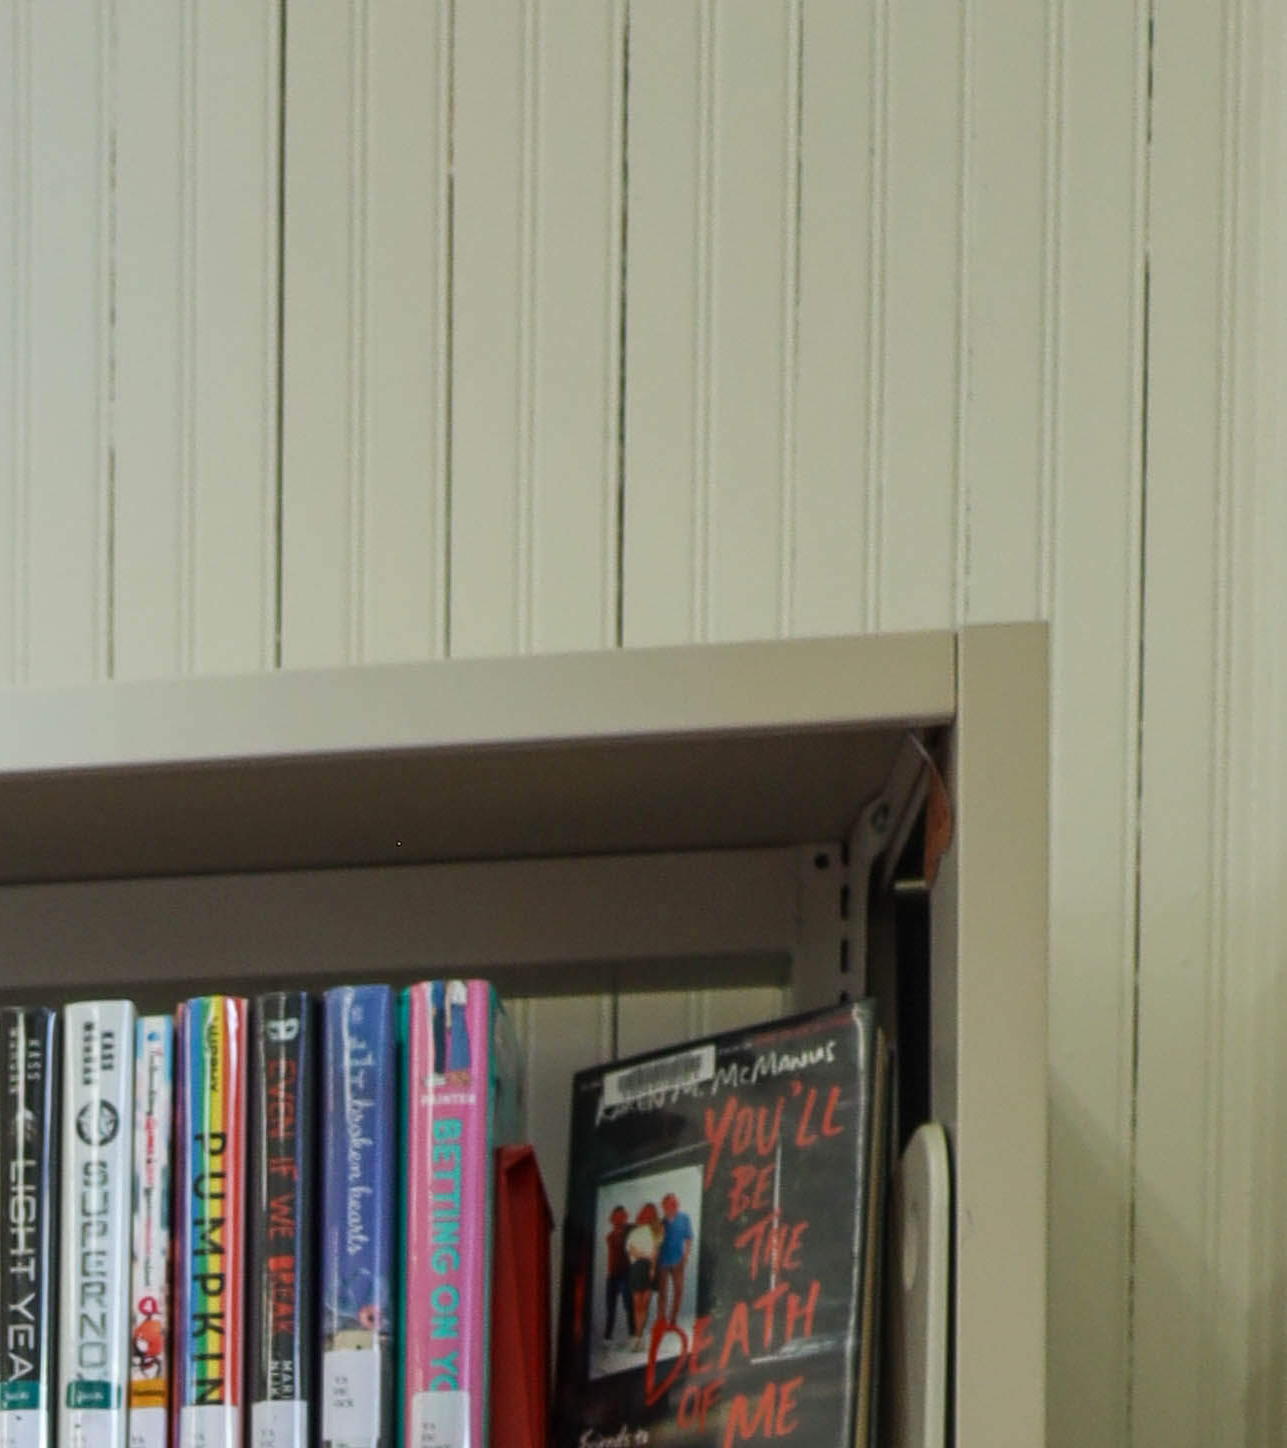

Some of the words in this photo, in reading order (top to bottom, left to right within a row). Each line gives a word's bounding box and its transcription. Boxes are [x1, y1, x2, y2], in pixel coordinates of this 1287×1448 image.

[705, 1080, 843, 1187] YOU'LL
[432, 1118, 461, 1274] BETTING
[728, 1165, 775, 1220] BE
[192, 1130, 225, 1405] PUMPKIN
[734, 1222, 808, 1281] THE
[431, 1286, 460, 1342] ON
[646, 1281, 820, 1406] DEATH
[678, 1380, 721, 1432] OF
